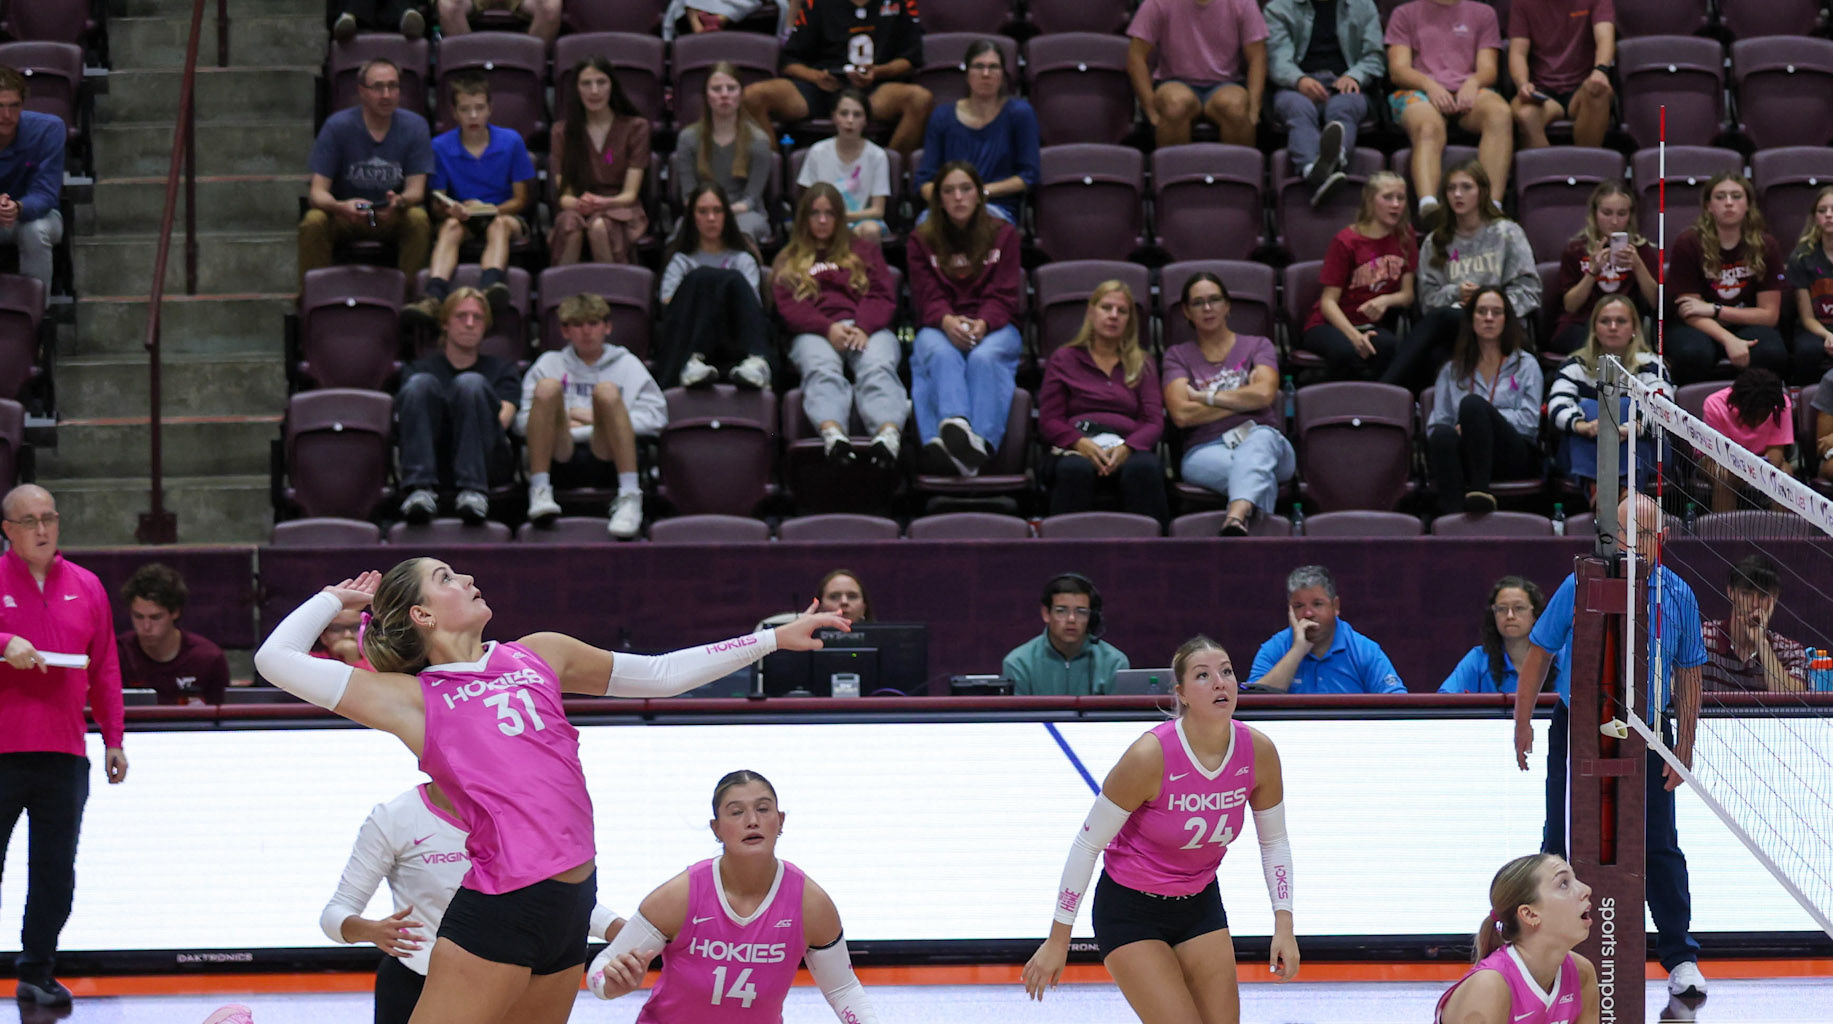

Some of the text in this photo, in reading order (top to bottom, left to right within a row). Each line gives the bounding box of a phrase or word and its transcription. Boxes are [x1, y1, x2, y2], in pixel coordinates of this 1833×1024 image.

[706, 636, 758, 655] HOKIES
[175, 676, 197, 689] VT
[442, 668, 545, 710] HOKIES
[482, 688, 546, 736] 31
[1167, 787, 1247, 812] HOKIES
[1178, 813, 1235, 850] 24
[1598, 897, 1618, 957] sports
[176, 952, 253, 963] DAKTRONICS
[689, 936, 787, 963] HOKIES
[711, 965, 758, 1009] 14
